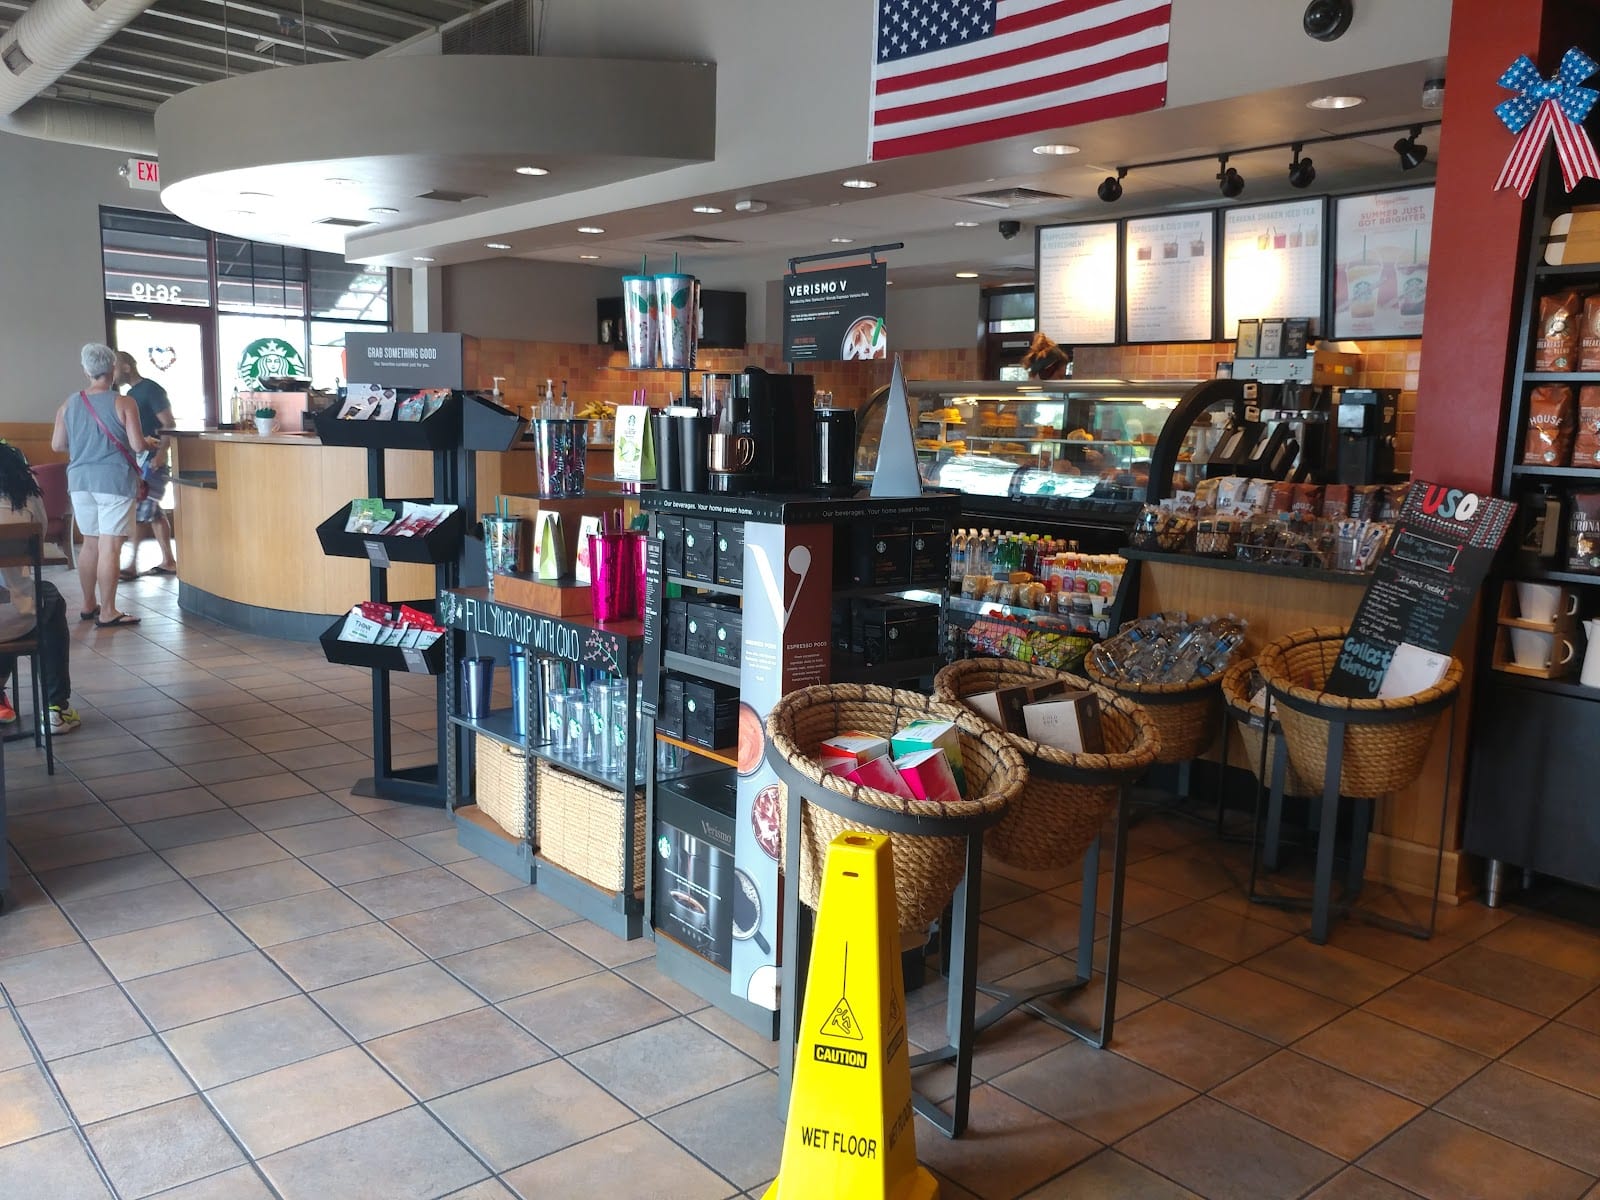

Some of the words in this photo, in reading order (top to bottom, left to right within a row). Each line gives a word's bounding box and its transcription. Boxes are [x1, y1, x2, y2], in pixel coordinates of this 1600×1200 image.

[137, 162, 158, 182] EXI
[1401, 206, 1424, 215] JUST
[789, 281, 837, 297] VERISMO
[840, 280, 847, 291] V
[367, 347, 384, 359] GRAB
[384, 347, 419, 360] SOMETHING
[419, 348, 437, 360] GOOD
[1529, 414, 1563, 427] HOUSE
[663, 500, 673, 508] Our
[672, 500, 697, 510] beverages.
[697, 503, 708, 511] Your
[708, 504, 723, 513] home
[723, 506, 738, 515] sweet
[738, 507, 754, 516] home.
[1422, 484, 1479, 522] USO
[1399, 575, 1424, 589] Items
[1424, 583, 1446, 596] needed
[466, 598, 492, 635] FILL
[489, 605, 515, 640] YOUR
[514, 611, 532, 645] CUP
[533, 618, 555, 654] WITH
[556, 623, 580, 662] COLD
[1340, 653, 1383, 693] throug
[701, 819, 732, 843] Verismo
[816, 1046, 866, 1067] CAUTION
[801, 1125, 829, 1150] WET
[832, 1132, 877, 1160] FLOOR
